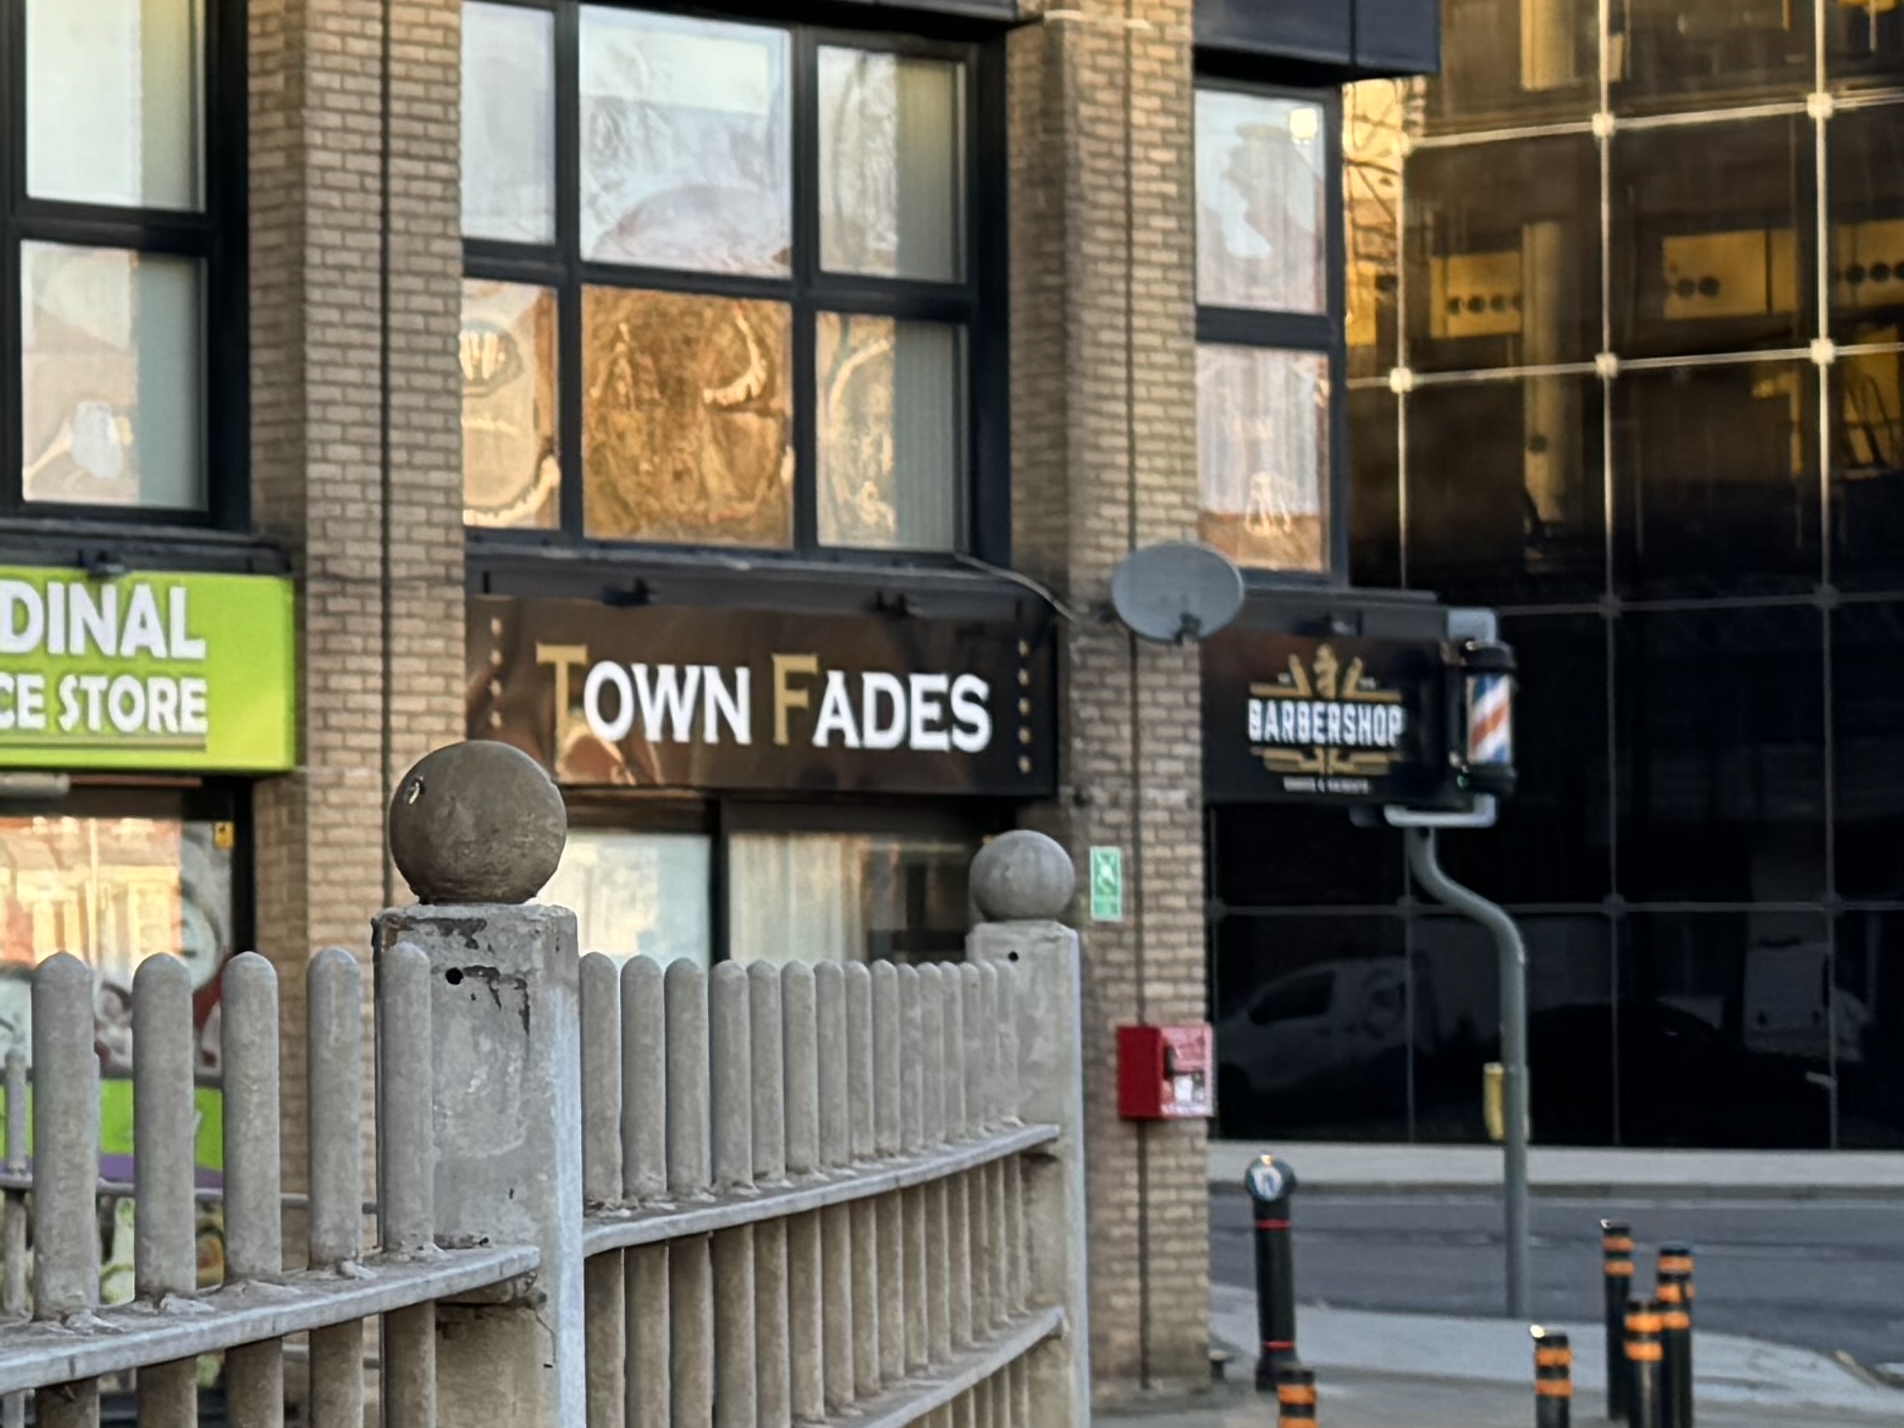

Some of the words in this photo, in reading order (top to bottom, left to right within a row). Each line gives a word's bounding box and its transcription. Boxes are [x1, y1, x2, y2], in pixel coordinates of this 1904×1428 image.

[57, 675, 209, 734] STORE
[535, 642, 752, 746] TOWN
[772, 653, 993, 753] FADES
[1247, 698, 1405, 748] BARBERSHOP
